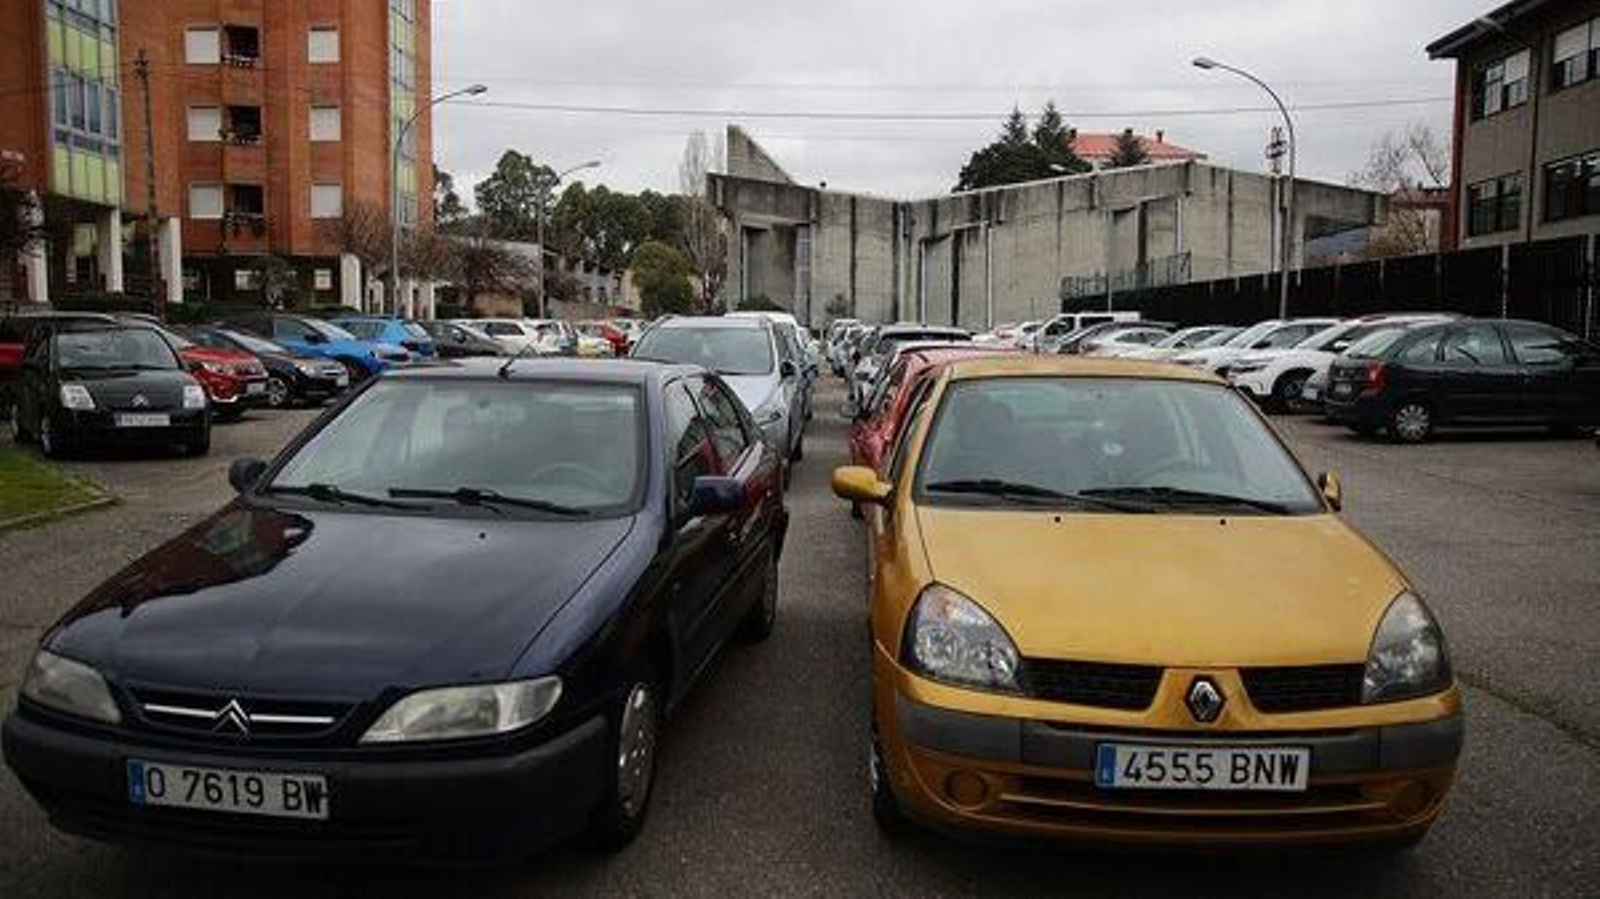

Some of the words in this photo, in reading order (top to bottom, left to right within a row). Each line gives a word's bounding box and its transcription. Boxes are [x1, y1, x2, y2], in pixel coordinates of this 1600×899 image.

[1124, 752, 1215, 783] 4555
[1230, 754, 1299, 785] BNW
[183, 772, 264, 807] 7619
[283, 779, 322, 813] BW
